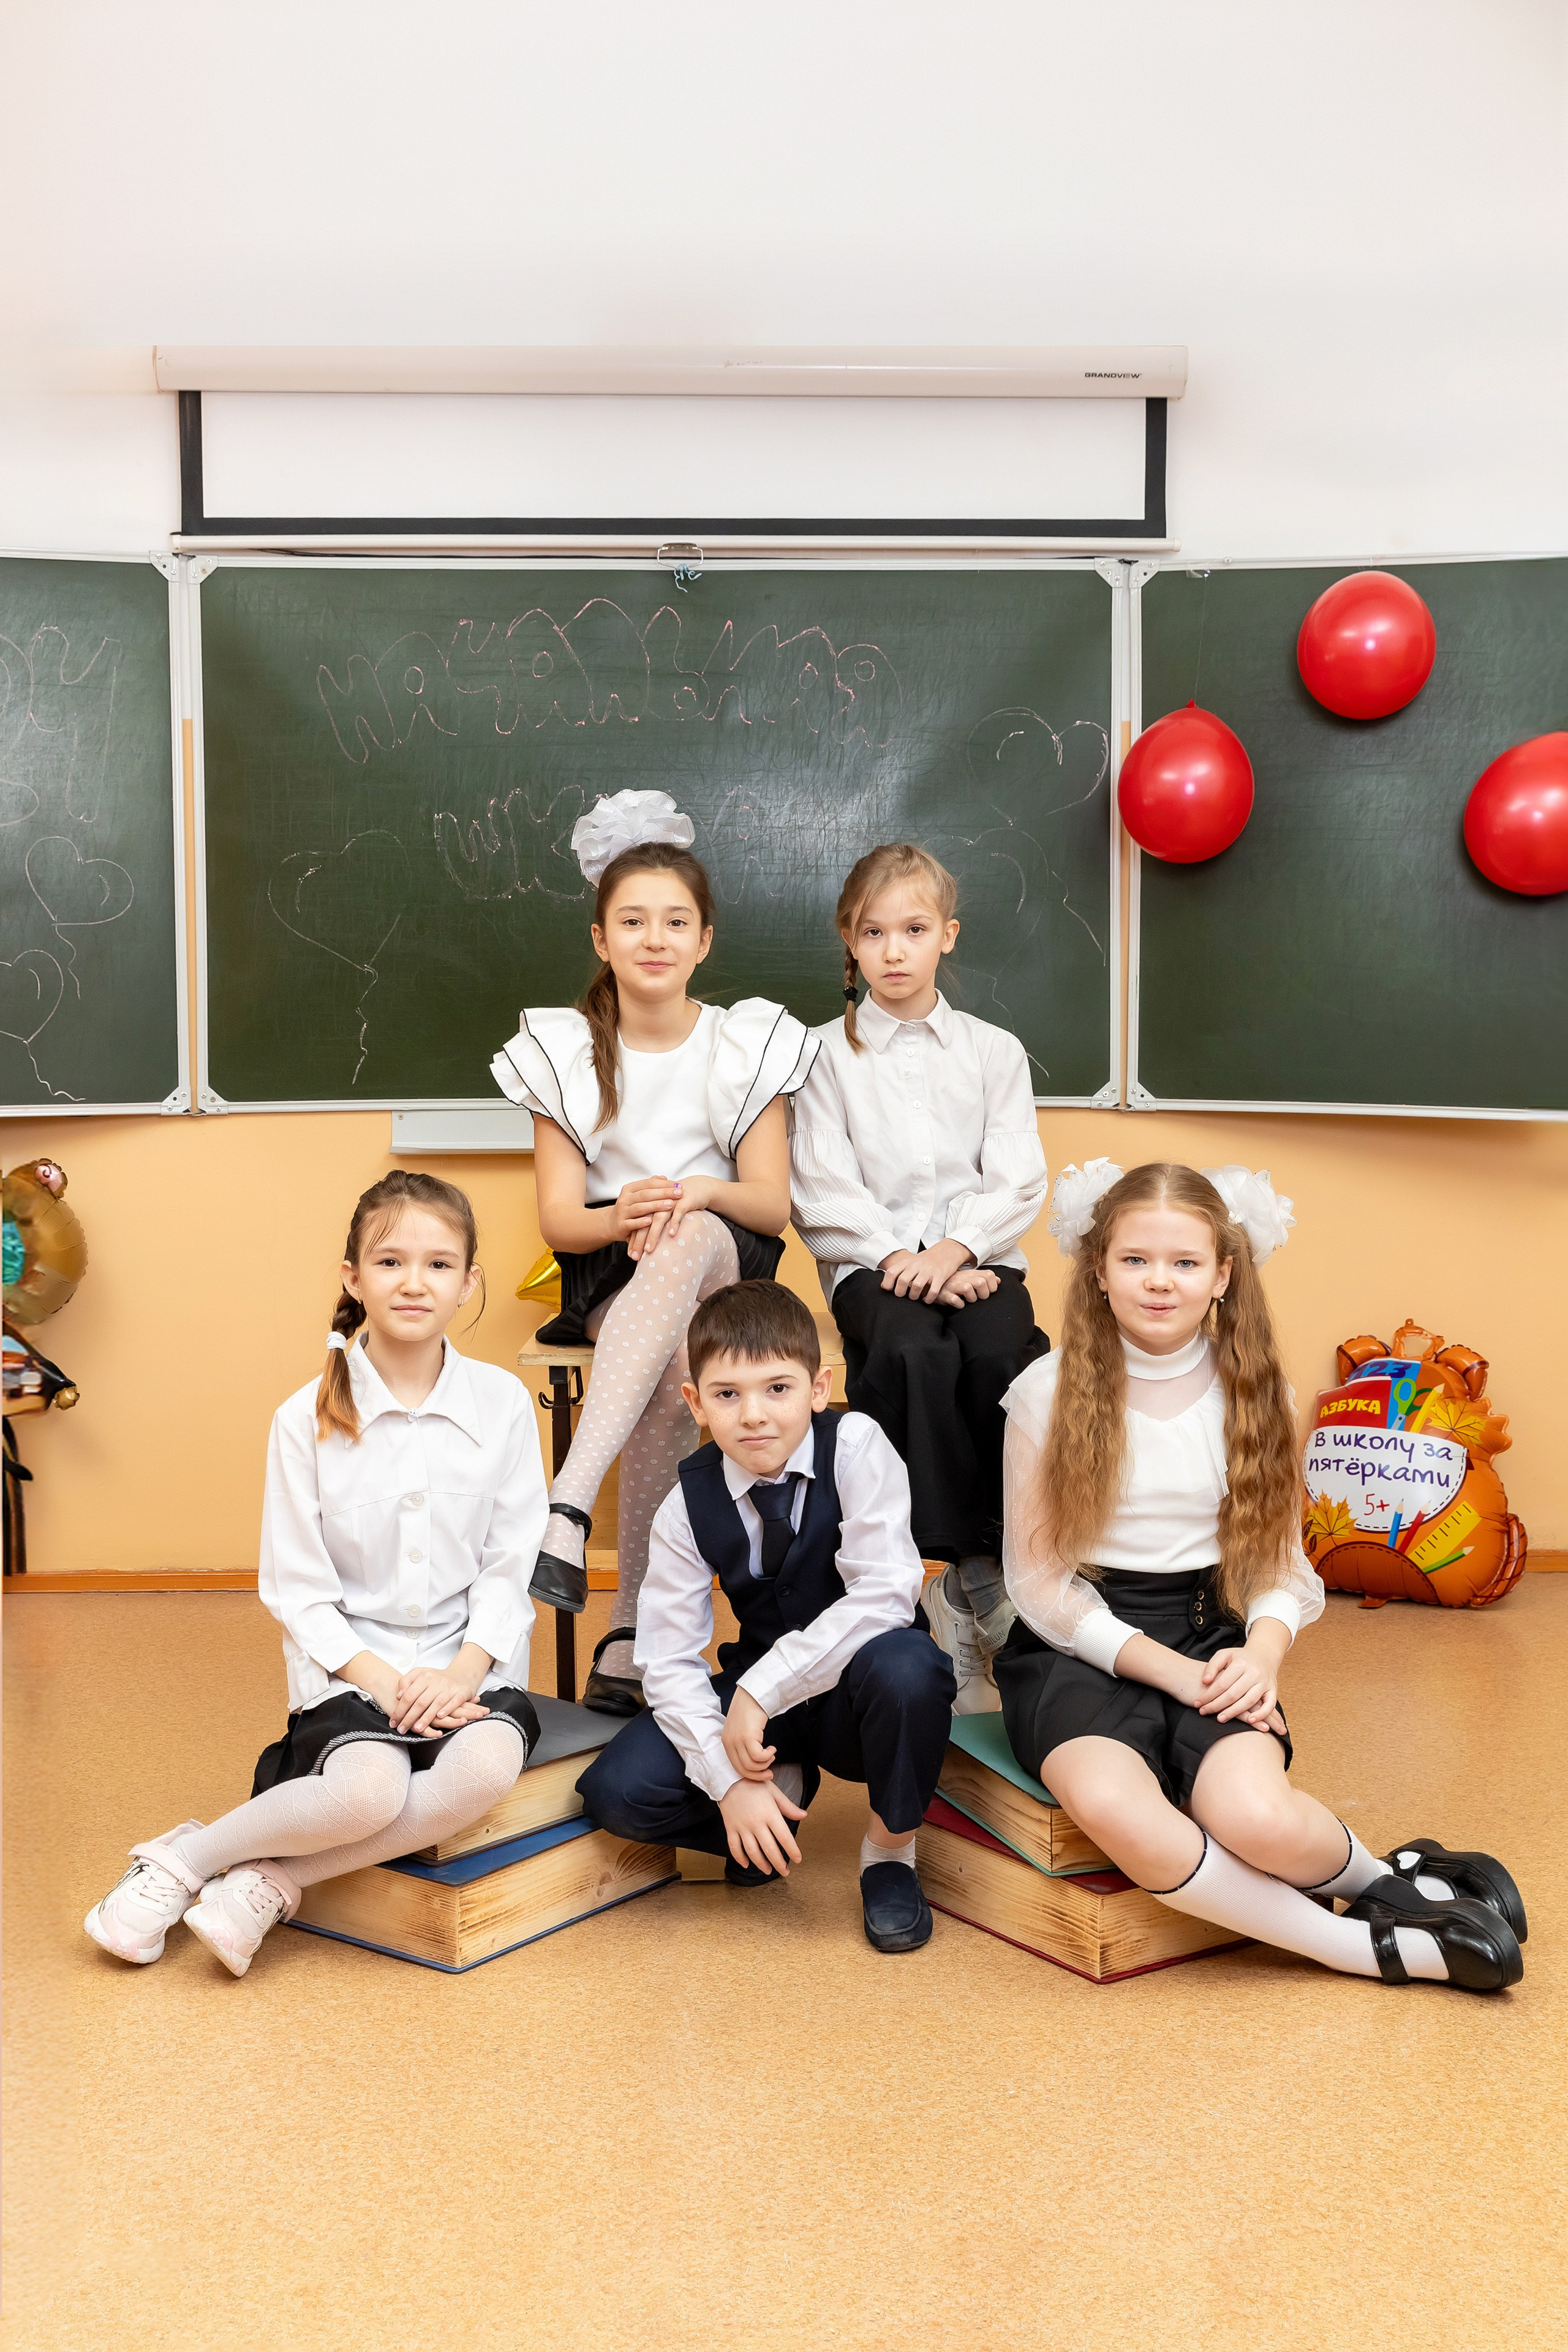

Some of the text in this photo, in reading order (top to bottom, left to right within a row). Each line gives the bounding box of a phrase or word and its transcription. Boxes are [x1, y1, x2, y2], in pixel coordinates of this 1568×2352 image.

[1319, 1398, 1381, 1419] АЗБУКА
[1333, 1433, 1415, 1463] школу
[1423, 1442, 1453, 1461] за
[1308, 1457, 1450, 1488] пятёрками
[1363, 1493, 1390, 1516] 5+
